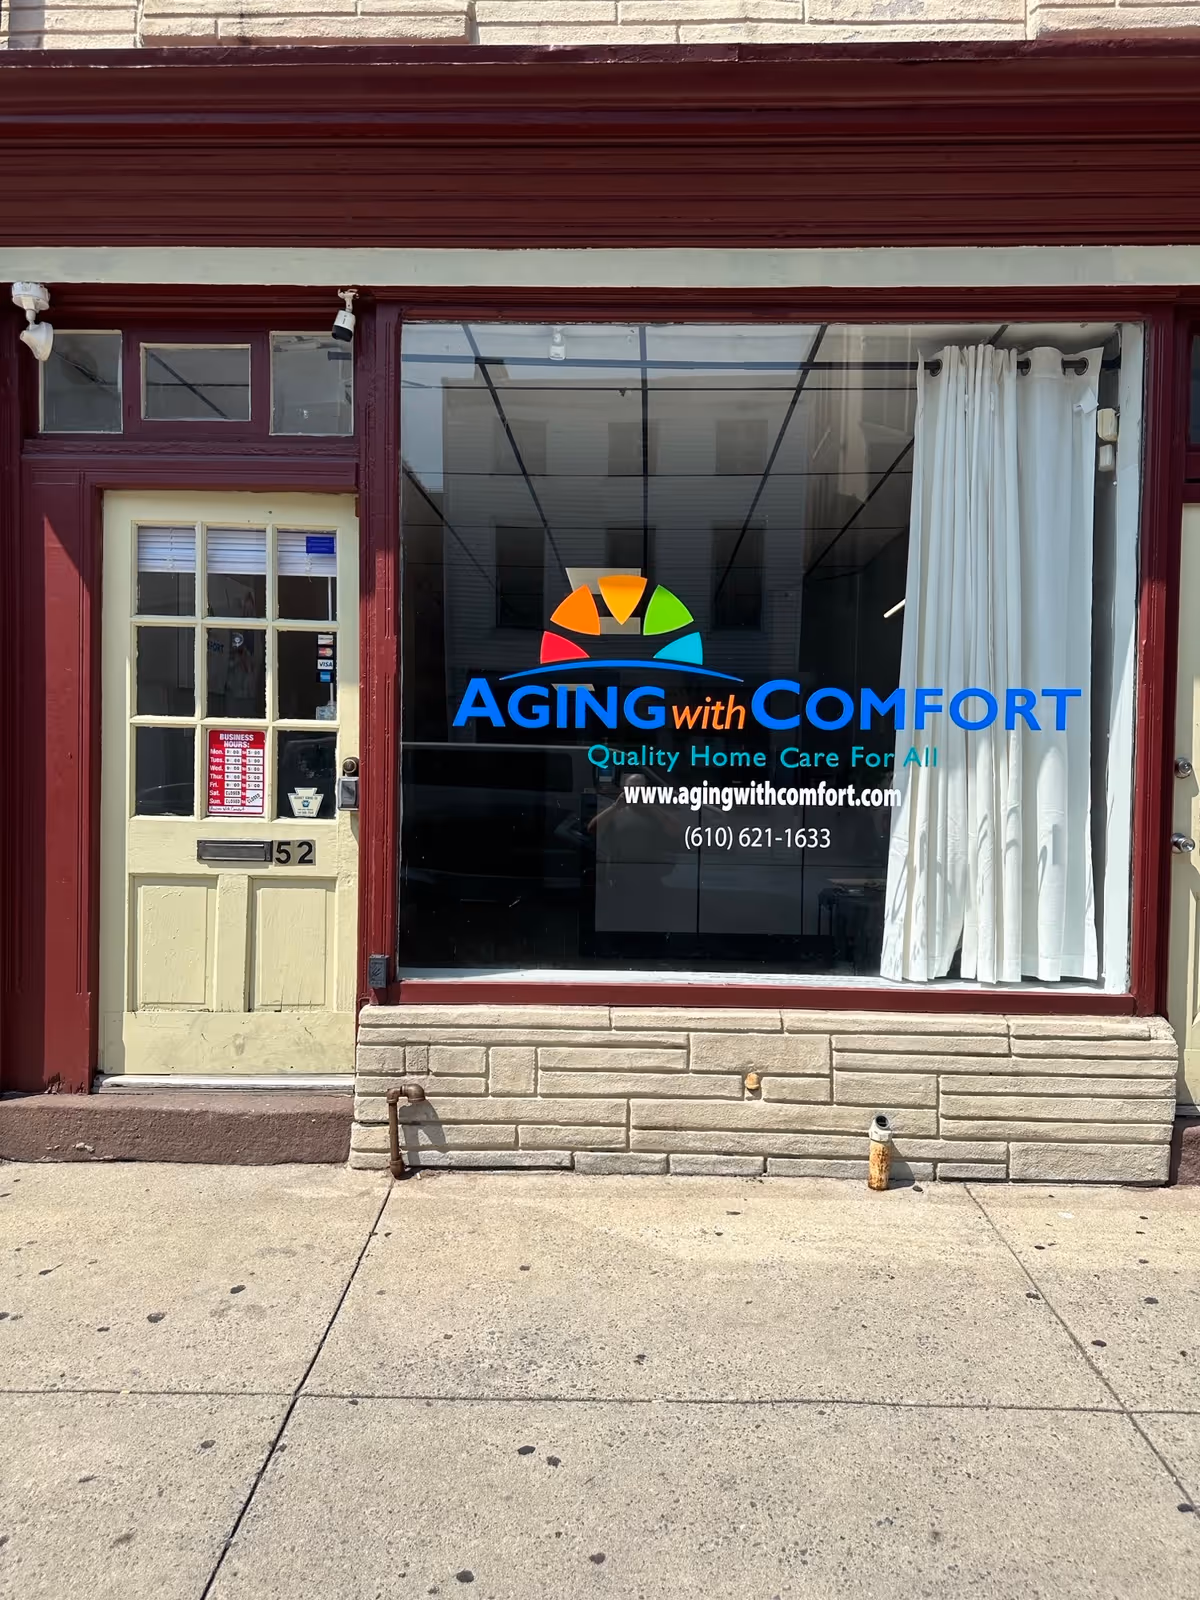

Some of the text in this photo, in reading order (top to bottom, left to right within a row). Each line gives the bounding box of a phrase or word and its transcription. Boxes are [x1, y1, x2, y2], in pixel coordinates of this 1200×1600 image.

[453, 677, 1082, 731] AGING with COMFORT
[219, 733, 254, 741] BUSINESS
[223, 740, 250, 748] HOURS:
[587, 743, 938, 773] Quality Home Care For All
[623, 780, 902, 811] www.agingwithcomfort.com
[684, 825, 831, 851] (610) 621-1633
[275, 840, 314, 865] 52
